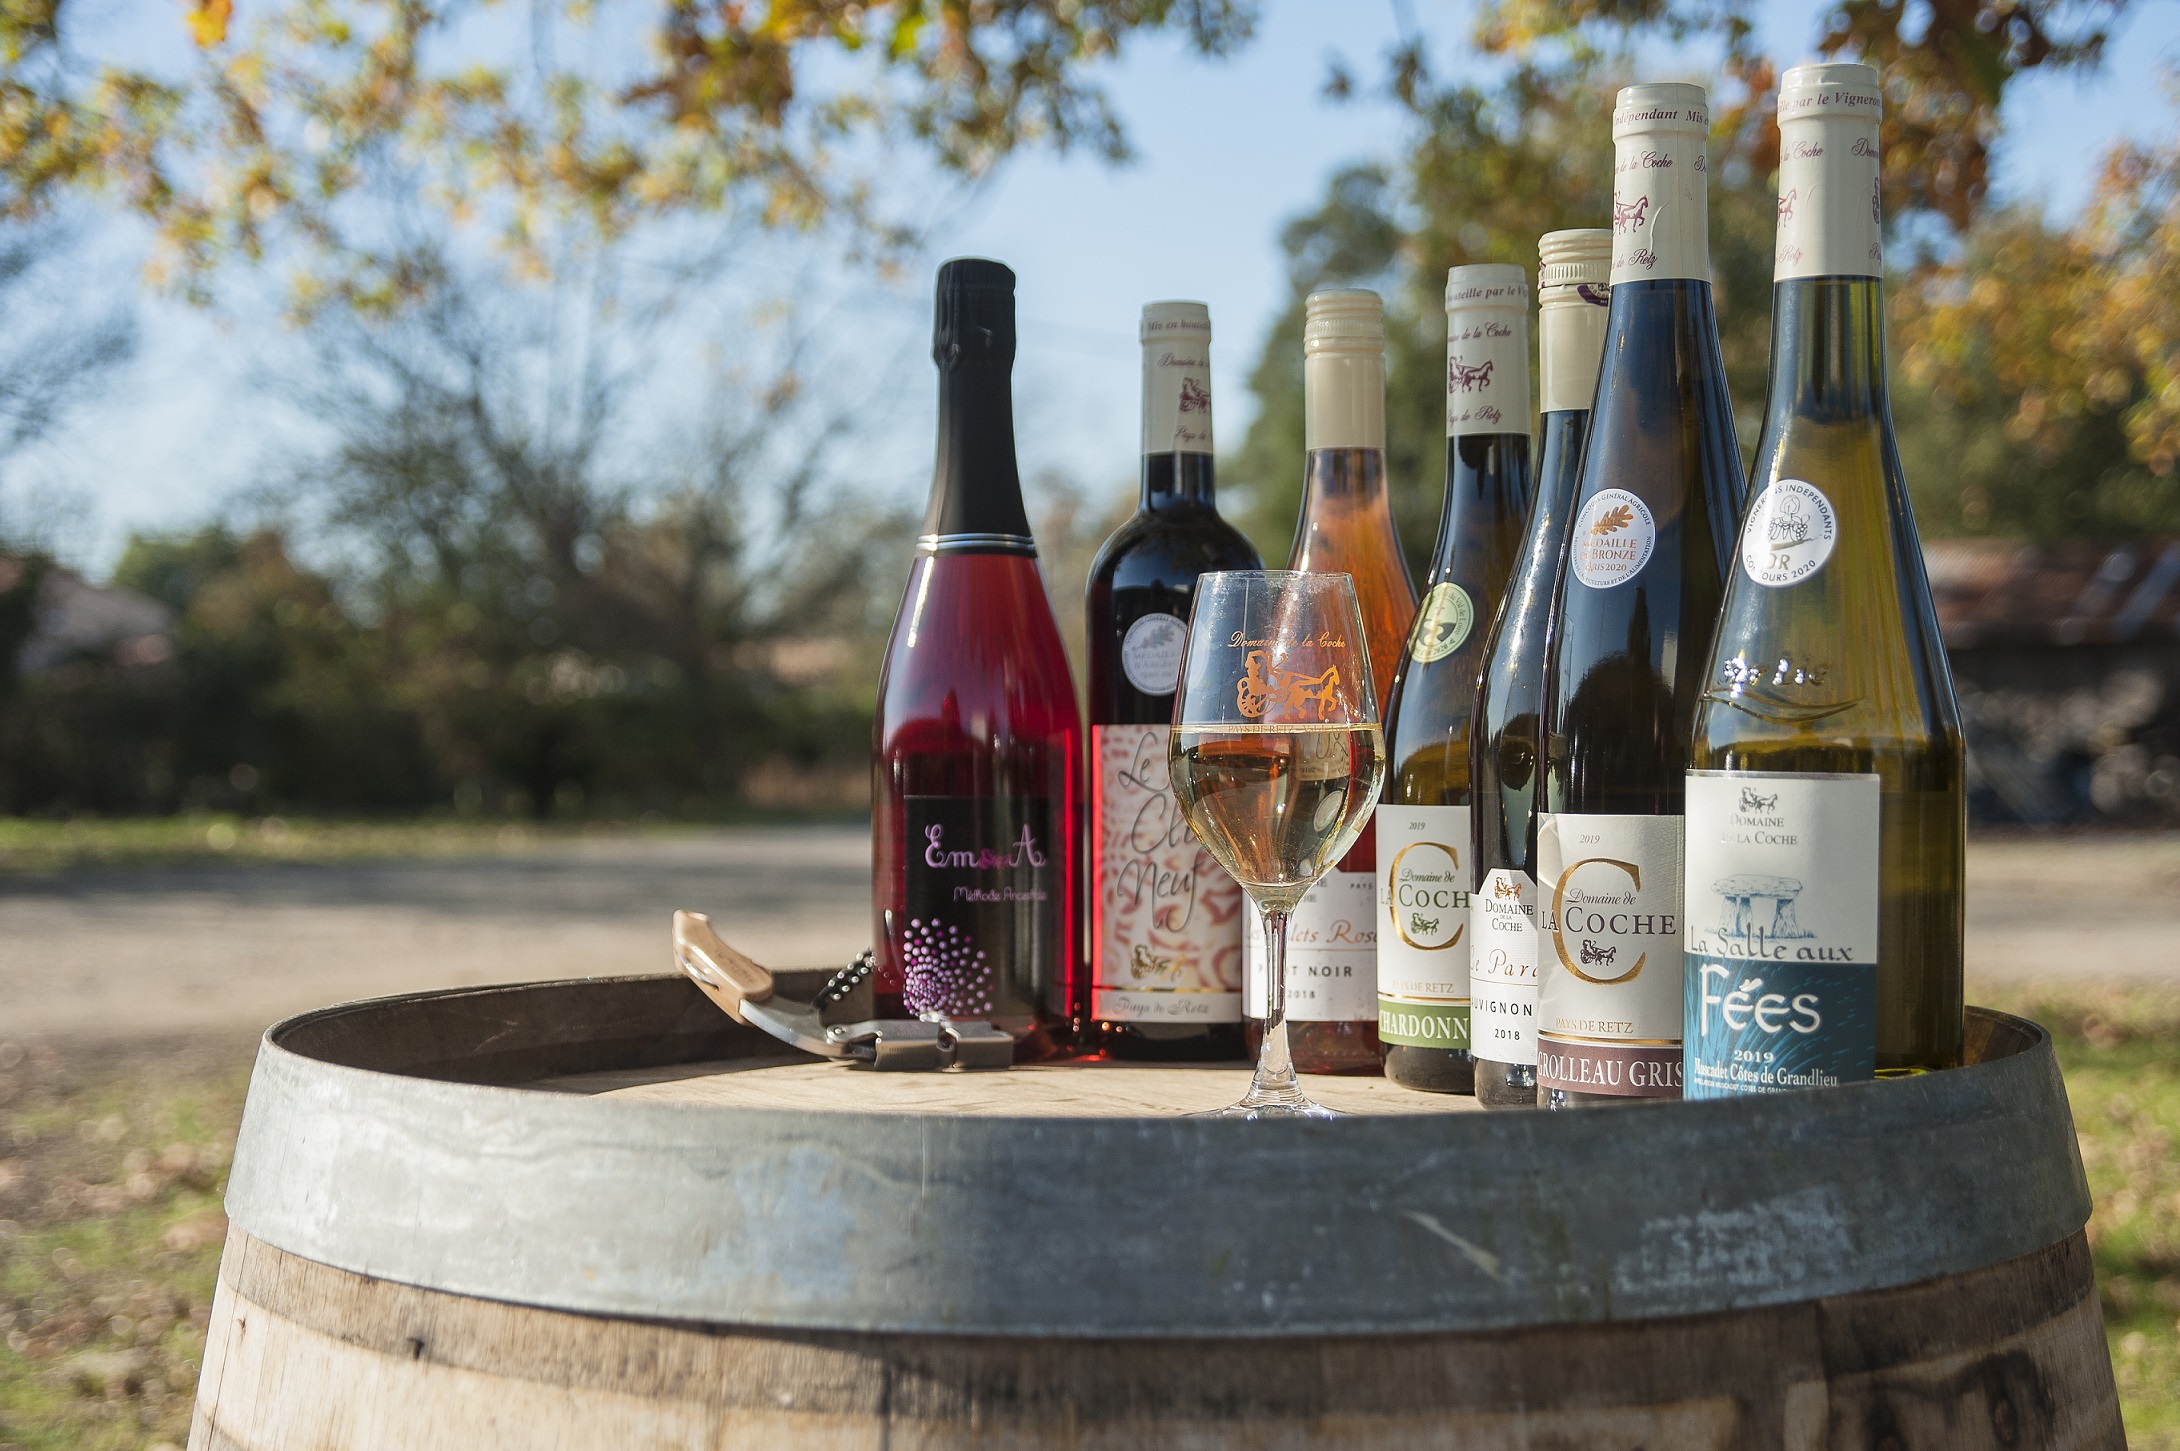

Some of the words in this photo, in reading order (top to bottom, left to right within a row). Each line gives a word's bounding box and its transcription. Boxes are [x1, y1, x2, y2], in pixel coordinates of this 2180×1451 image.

[1817, 93, 1830, 105] le
[1685, 110, 1703, 124] Mis
[1791, 141, 1824, 160] Coche
[1640, 150, 1674, 169] Coche
[1485, 287, 1504, 299] par
[1507, 285, 1516, 296] le
[1473, 325, 1483, 339] la
[1484, 322, 1512, 337] Coche
[1627, 498, 1652, 526] AGRICOLE
[1746, 484, 1783, 533] VIGNERS
[1785, 484, 1832, 540] INDEPENDANTS
[1582, 538, 1637, 549] MDAILLE
[1591, 549, 1637, 561] BRONZE
[1605, 563, 1628, 572] 2020
[1745, 554, 1788, 581] CONOURS
[1791, 559, 1817, 578] 2020
[1228, 631, 1280, 648] Domain
[1301, 633, 1315, 648] la
[1317, 631, 1347, 648] Coche
[1118, 732, 1170, 792] Le
[1409, 822, 1426, 830] 2019
[1730, 813, 1785, 828] DOMAINE
[1579, 835, 1600, 844] 2019
[1737, 835, 1750, 843] LA
[1754, 831, 1798, 845] COCHE
[1399, 868, 1442, 883] Domaine
[1444, 870, 1455, 883] de
[1117, 846, 1204, 933] Neuf
[1398, 884, 1471, 909] COCH
[1566, 888, 1621, 905] Domaine
[1622, 891, 1637, 906] de
[1485, 899, 1533, 916] DOMAINE
[1491, 918, 1524, 932] COCHE
[1541, 911, 1560, 931] LA
[1565, 907, 1677, 935] COCHE
[1690, 925, 1708, 953] La
[1717, 922, 1788, 960] Salle
[1796, 946, 1854, 961] aux
[1308, 966, 1353, 977] NOIR
[1287, 989, 1316, 998] 2018
[1425, 983, 1455, 993] RETZ
[1699, 963, 1822, 1038] Fées
[1379, 1009, 1470, 1039] CHARDONN
[1555, 1017, 1577, 1030] PAYS
[1579, 1020, 1596, 1031] DE
[1598, 1021, 1634, 1034] RETZ
[1494, 1028, 1521, 1041] 2018
[1734, 1050, 1774, 1063] 2019
[1538, 1051, 1623, 1086] GROLLEAU
[1628, 1061, 1683, 1087] GRIS
[1694, 1057, 1728, 1080] Muscadet
[1729, 1063, 1759, 1084] Côtes
[1760, 1065, 1774, 1084] de
[1776, 1067, 1838, 1087] Grandlieu
